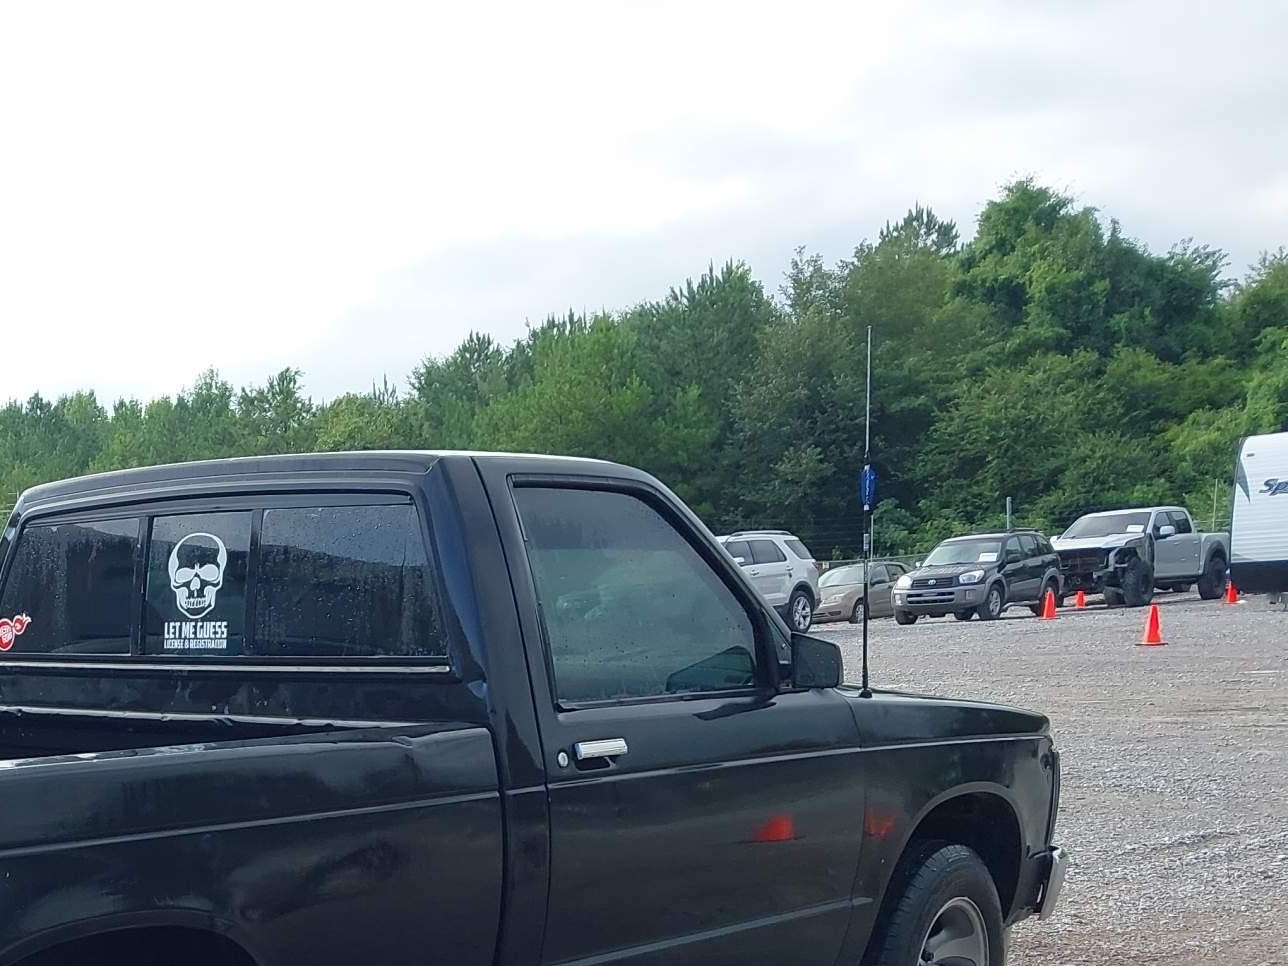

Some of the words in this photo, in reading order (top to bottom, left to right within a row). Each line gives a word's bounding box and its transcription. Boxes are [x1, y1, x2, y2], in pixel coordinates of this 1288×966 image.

[164, 622, 181, 639] LET
[181, 621, 195, 639] ME
[196, 621, 228, 639] GUESS
[163, 639, 184, 649] LICENSE
